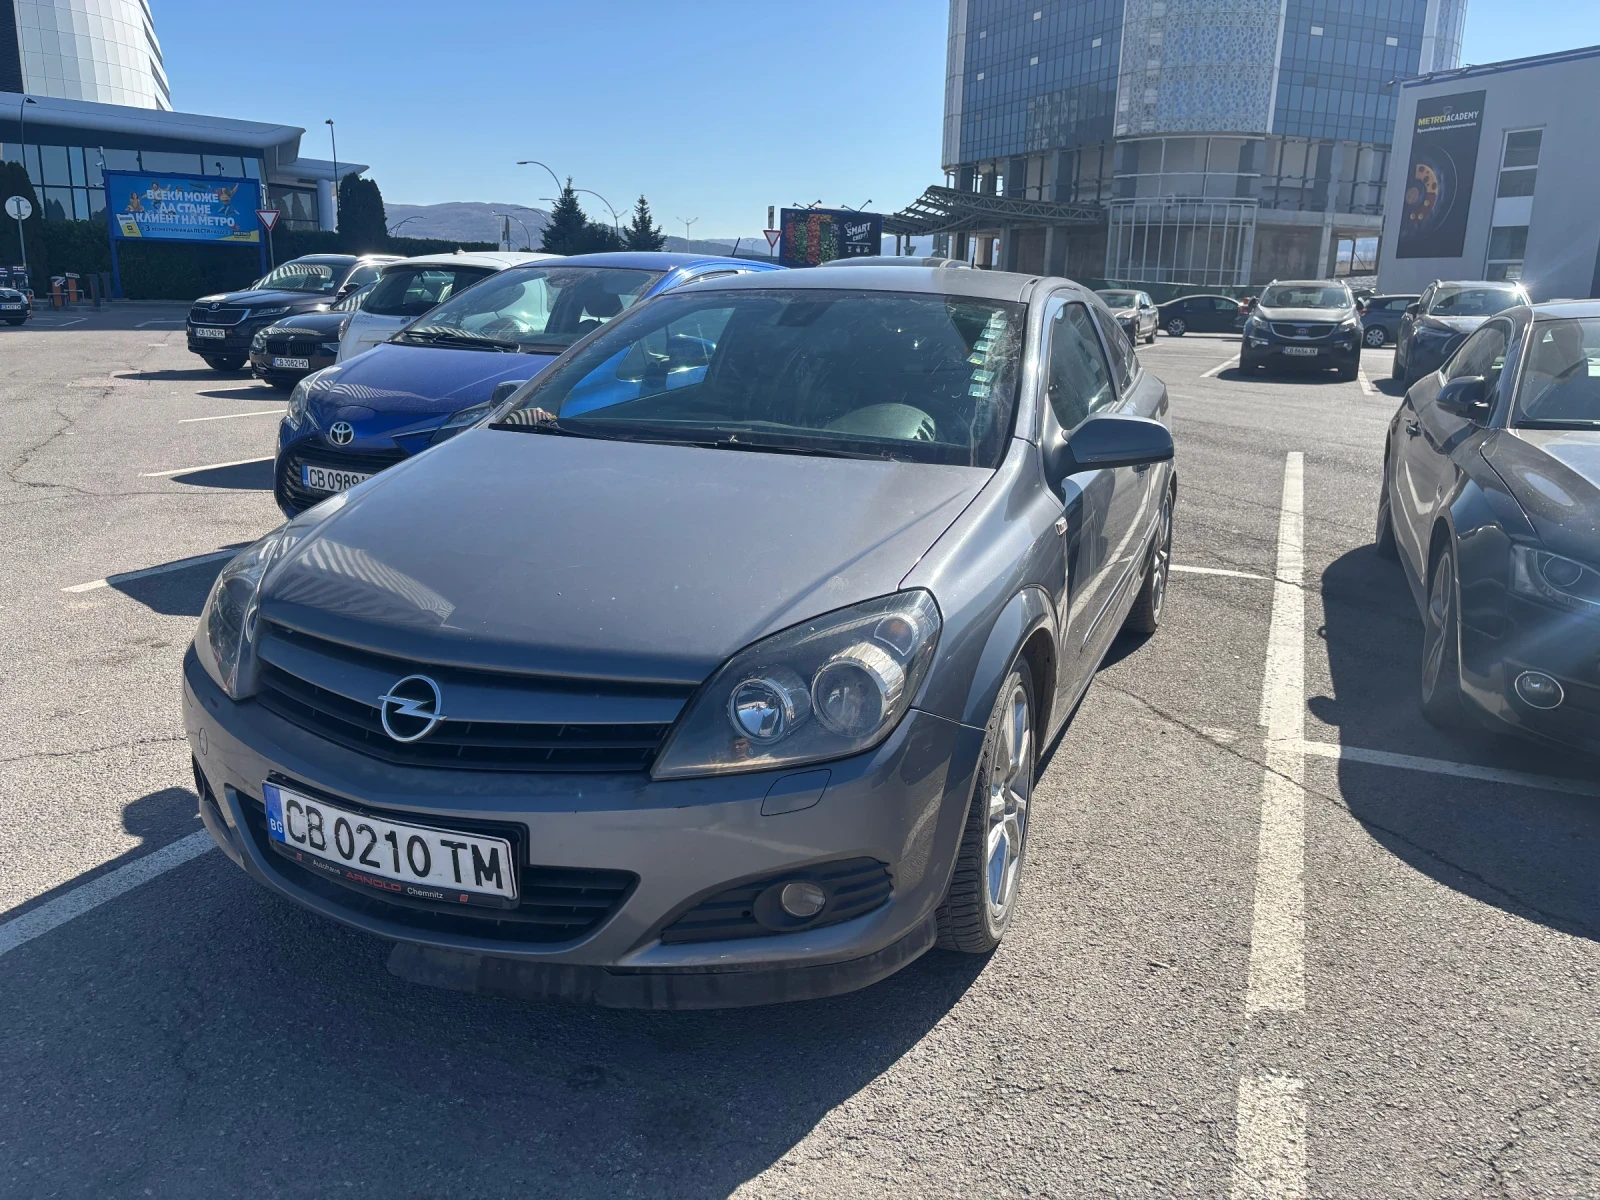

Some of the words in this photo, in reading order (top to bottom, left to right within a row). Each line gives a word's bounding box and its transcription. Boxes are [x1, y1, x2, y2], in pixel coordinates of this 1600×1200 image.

[147, 190, 183, 200] ВСЕКИ
[184, 192, 219, 202] МОЖЕ
[160, 202, 176, 213] ДА
[177, 203, 211, 214] СТАНЕ
[135, 213, 180, 224] КЛИЕНТ
[181, 215, 197, 225] НА
[198, 216, 235, 226] МЕТРО
[846, 222, 871, 236] SMART
[276, 358, 284, 367] CB
[309, 469, 325, 488] CB
[270, 818, 283, 833] BG
[287, 799, 327, 851] CB
[335, 817, 432, 878] 0210
[441, 839, 503, 890] TM
[346, 871, 401, 892] ARNOLD
[407, 886, 443, 899] Chemnitz
